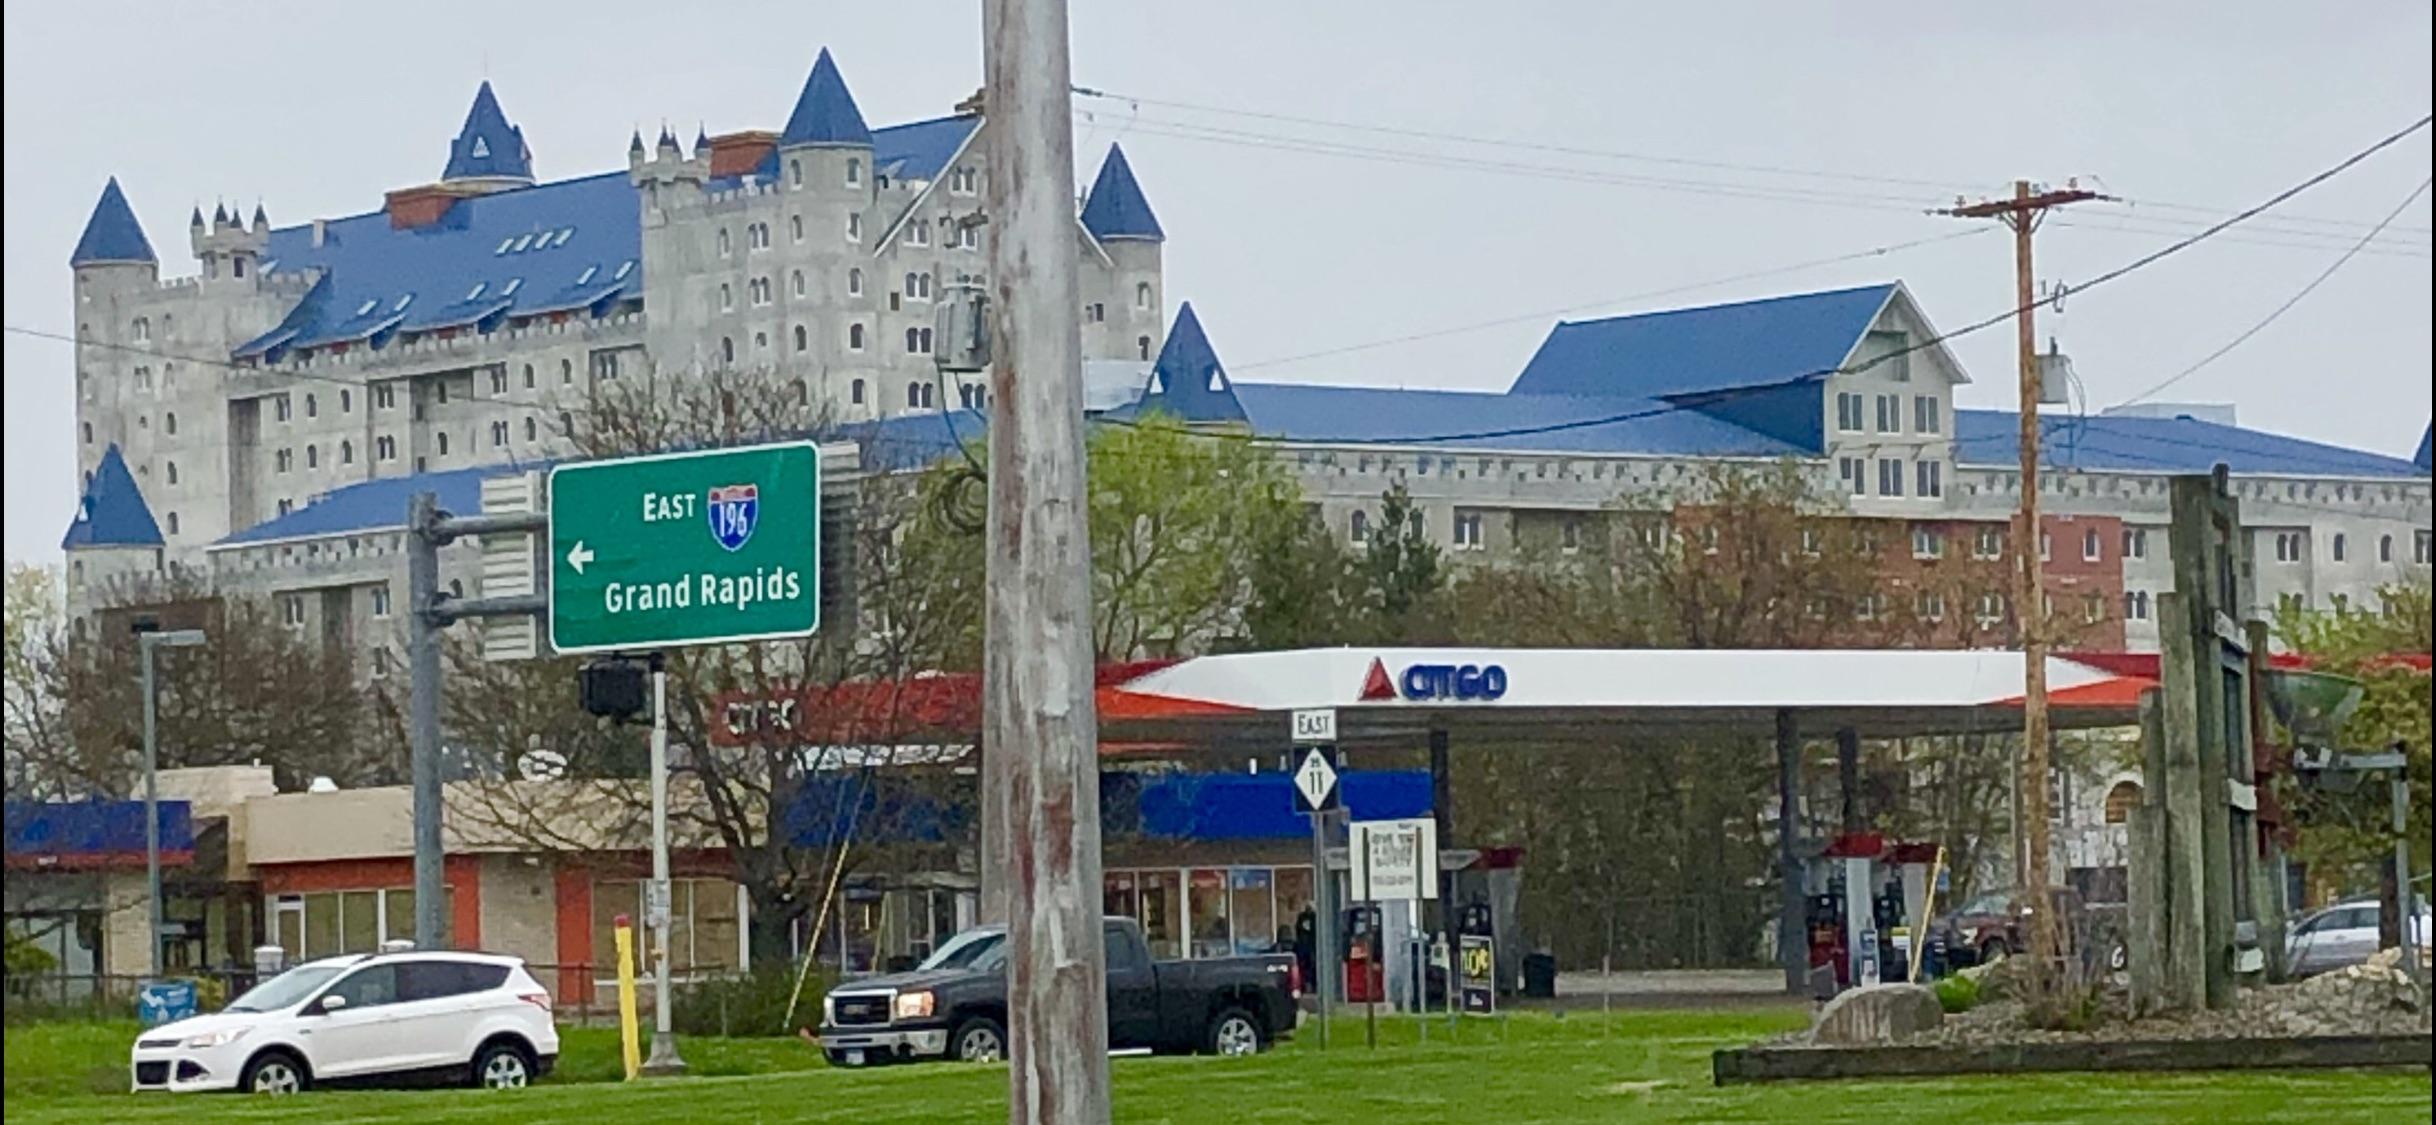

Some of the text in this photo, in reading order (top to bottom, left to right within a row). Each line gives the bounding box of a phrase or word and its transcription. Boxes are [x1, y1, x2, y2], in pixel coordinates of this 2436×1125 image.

[643, 492, 749, 538] EAST 196
[605, 565, 801, 613] Grand Rapids
[1401, 664, 1508, 701] CITGO
[1298, 713, 1330, 735] EAST
[1309, 771, 1324, 795] 11
